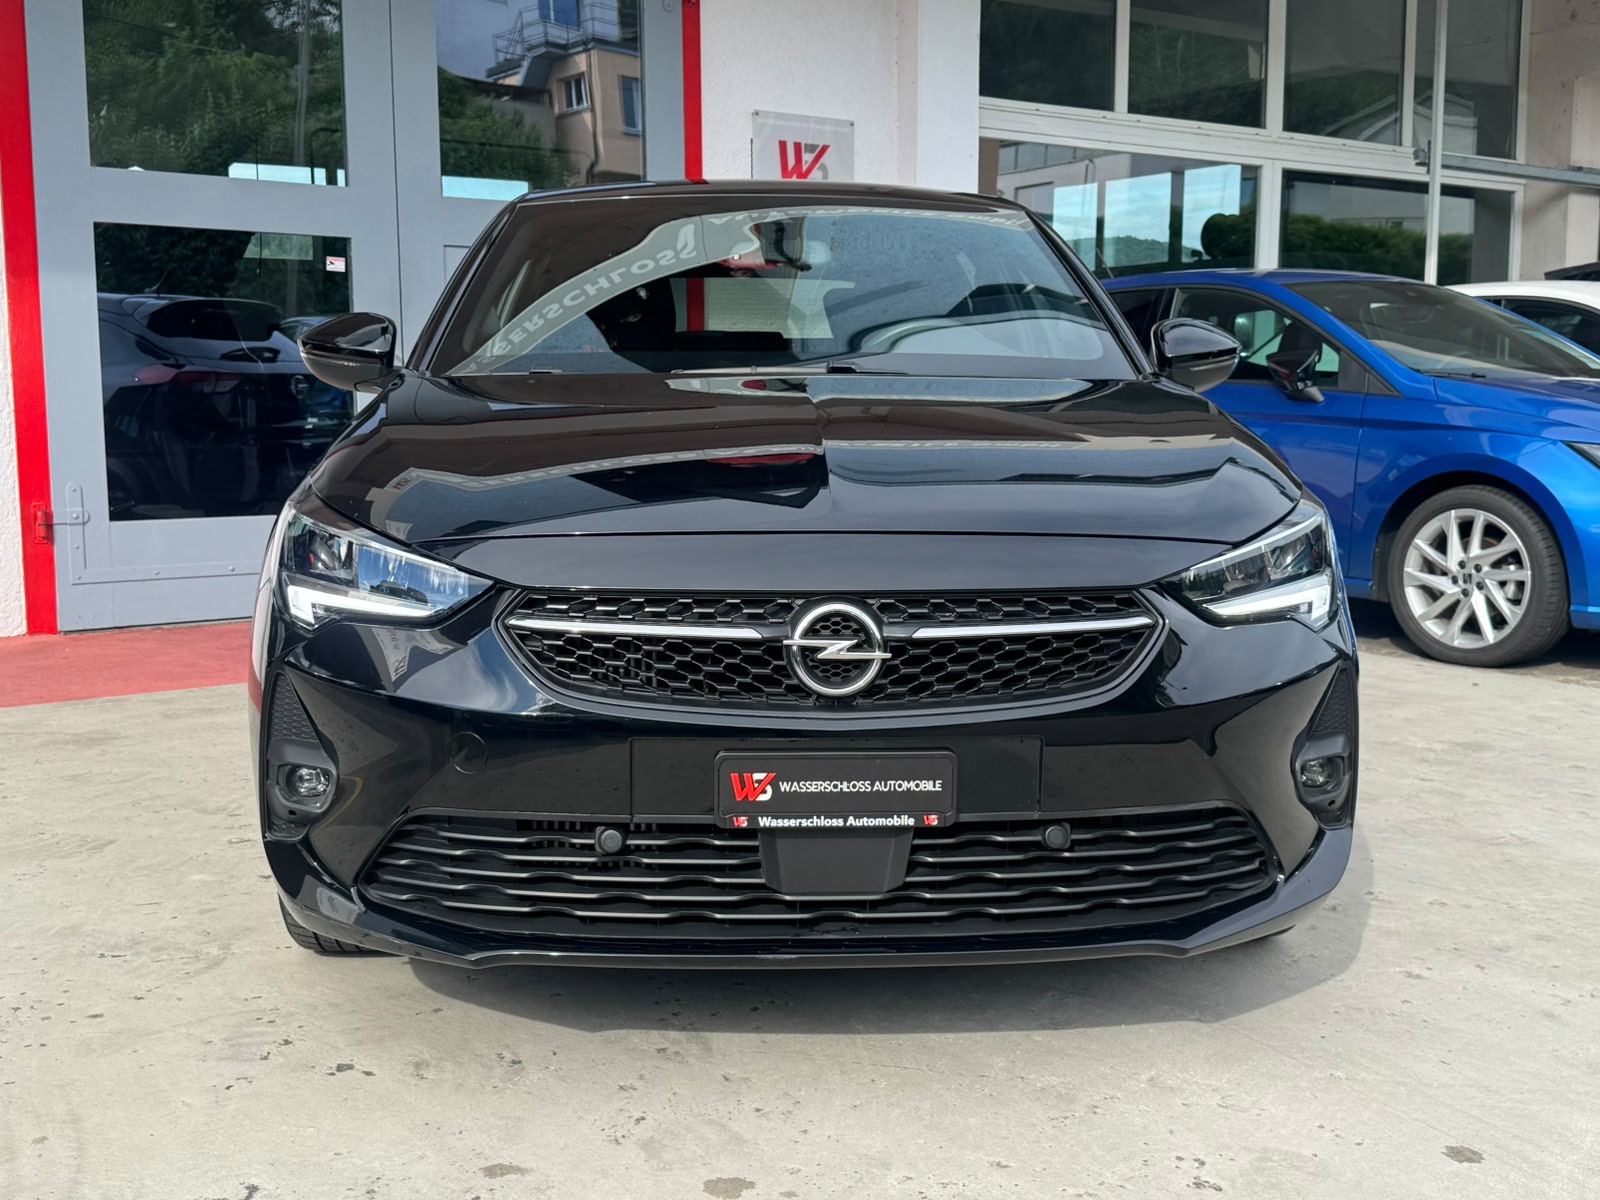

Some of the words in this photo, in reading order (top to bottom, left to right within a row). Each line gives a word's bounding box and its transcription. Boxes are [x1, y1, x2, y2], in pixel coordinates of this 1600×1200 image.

[779, 780, 872, 793] WASSERSCHLOSS
[873, 780, 943, 792] AUTOMOBILE
[758, 816, 845, 828] Wasserschloss
[846, 815, 916, 828] Automobile
